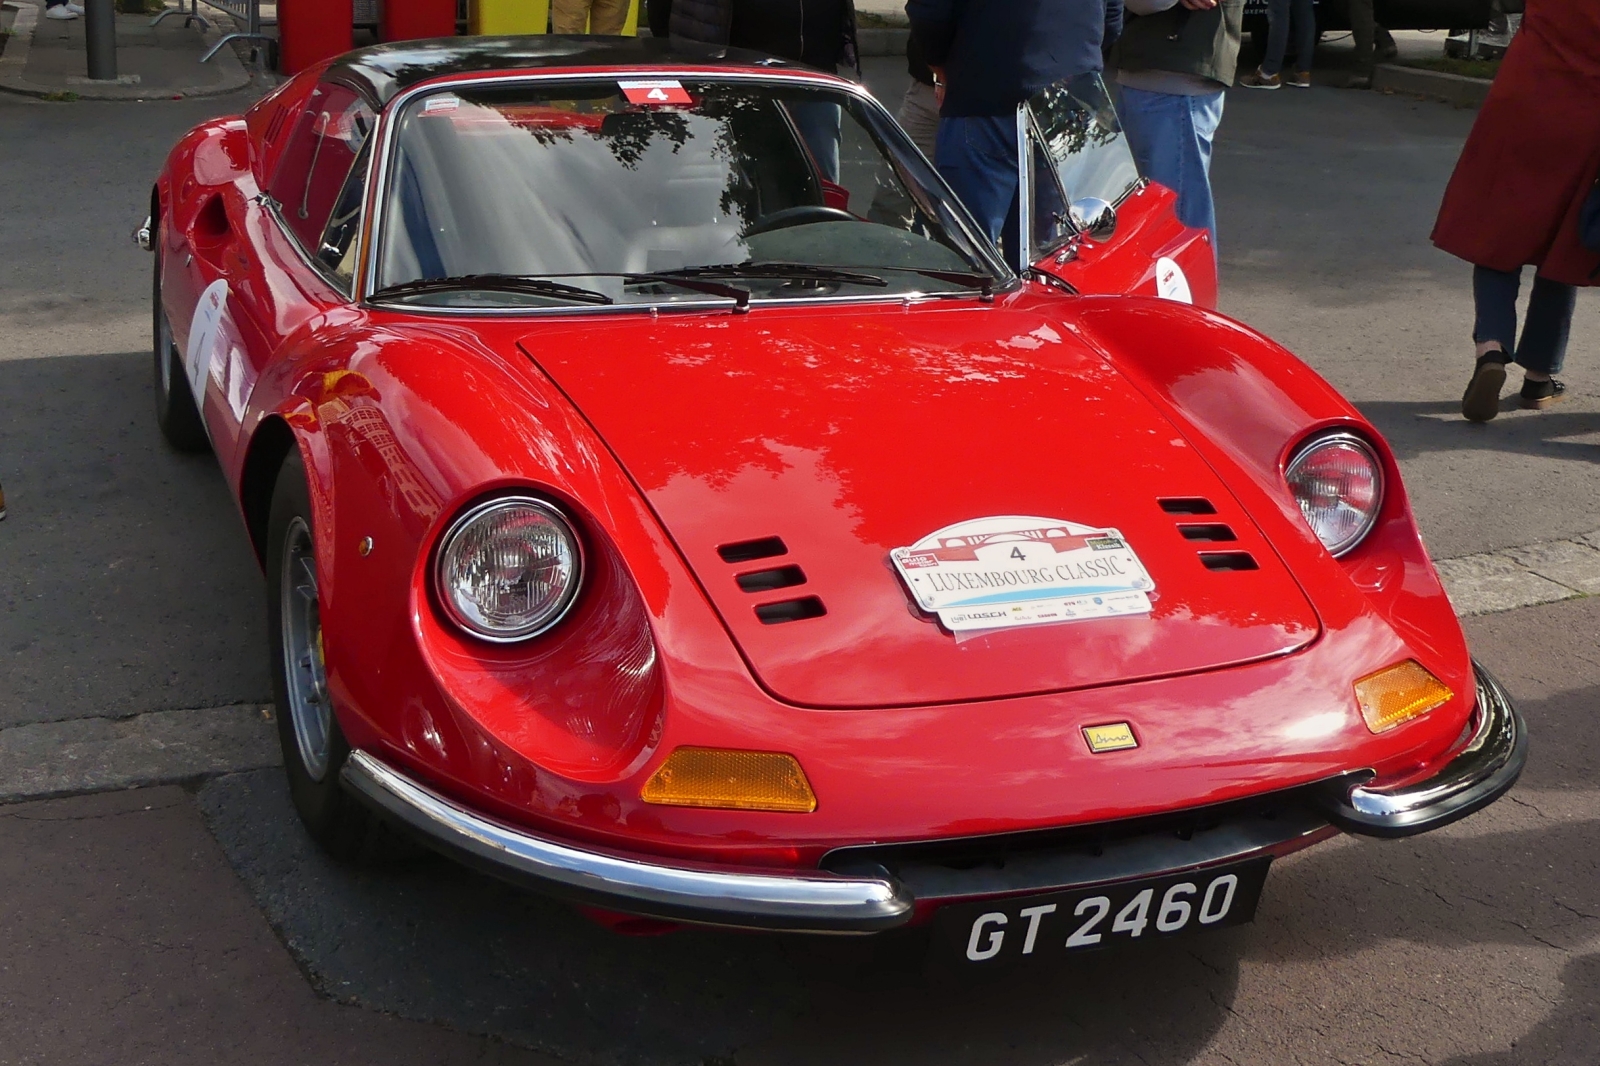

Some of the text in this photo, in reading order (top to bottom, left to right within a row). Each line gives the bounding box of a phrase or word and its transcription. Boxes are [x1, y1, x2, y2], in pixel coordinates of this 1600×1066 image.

[647, 88, 669, 100] 4
[1010, 546, 1026, 561] 4
[926, 555, 1126, 592] LUXEMBOURG CLASSIC
[967, 611, 1007, 620] LOSCH
[1095, 733, 1129, 744] Dino
[966, 873, 1238, 962] GT 2460
